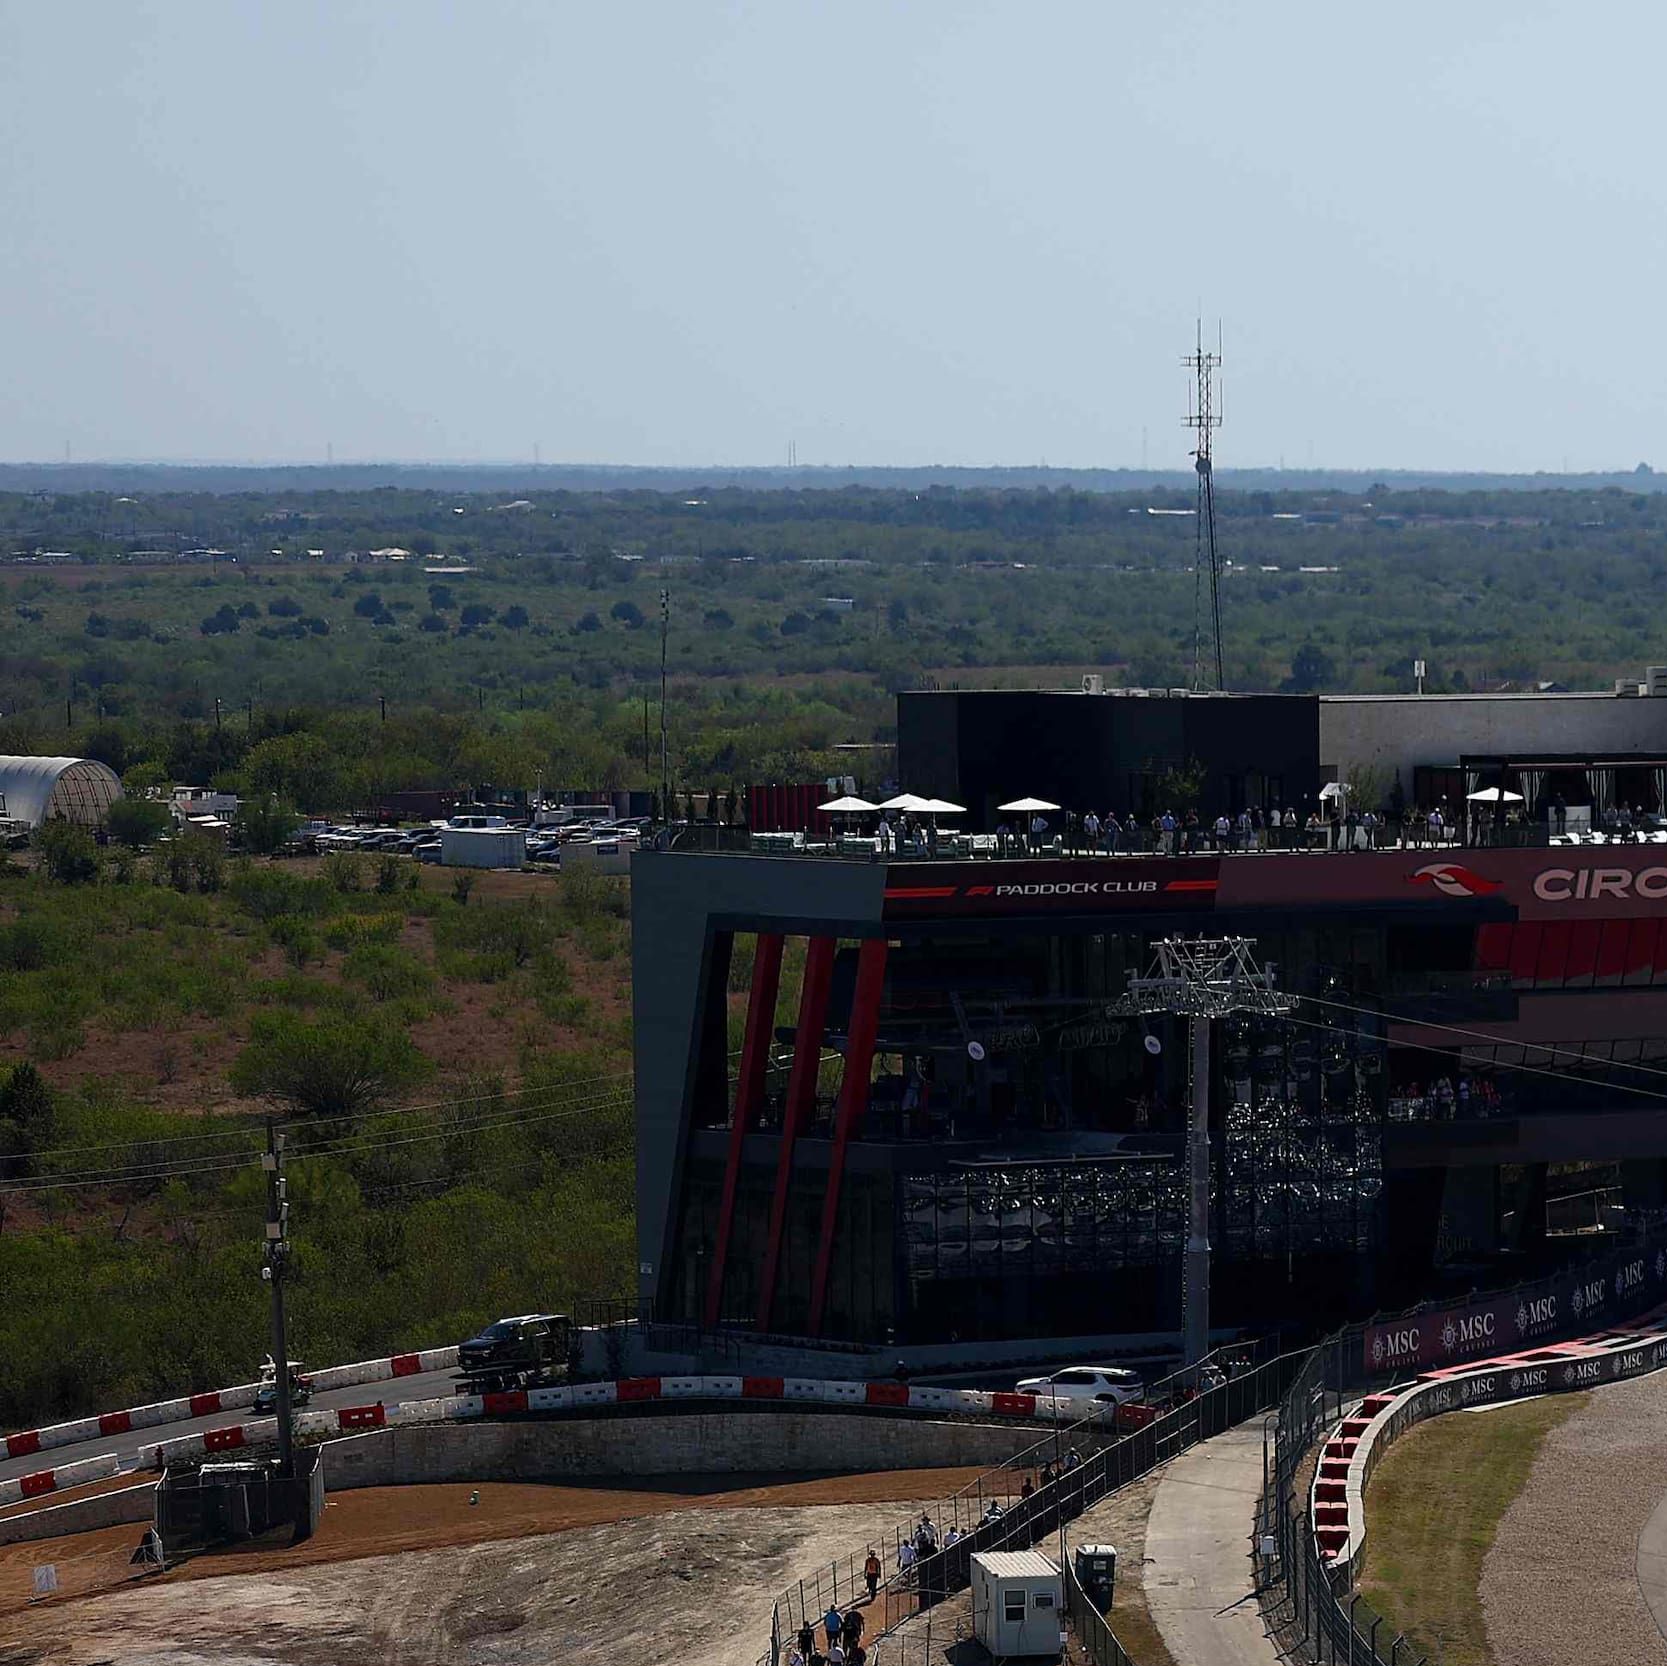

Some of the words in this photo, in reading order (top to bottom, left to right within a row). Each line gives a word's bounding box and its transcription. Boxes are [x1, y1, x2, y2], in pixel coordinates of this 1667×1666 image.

[996, 882, 1098, 896] PADDOCK
[1103, 880, 1157, 893] CLUB
[1623, 1259, 1644, 1288] MSC
[1584, 1279, 1605, 1306] MSC
[1529, 1296, 1556, 1325] MSC
[1459, 1312, 1495, 1342] MSC
[1386, 1328, 1420, 1356] MSC
[1577, 1361, 1600, 1380] MSC
[1622, 1352, 1643, 1370] MSC
[1471, 1377, 1495, 1396] MSC
[1522, 1369, 1548, 1388] MSC
